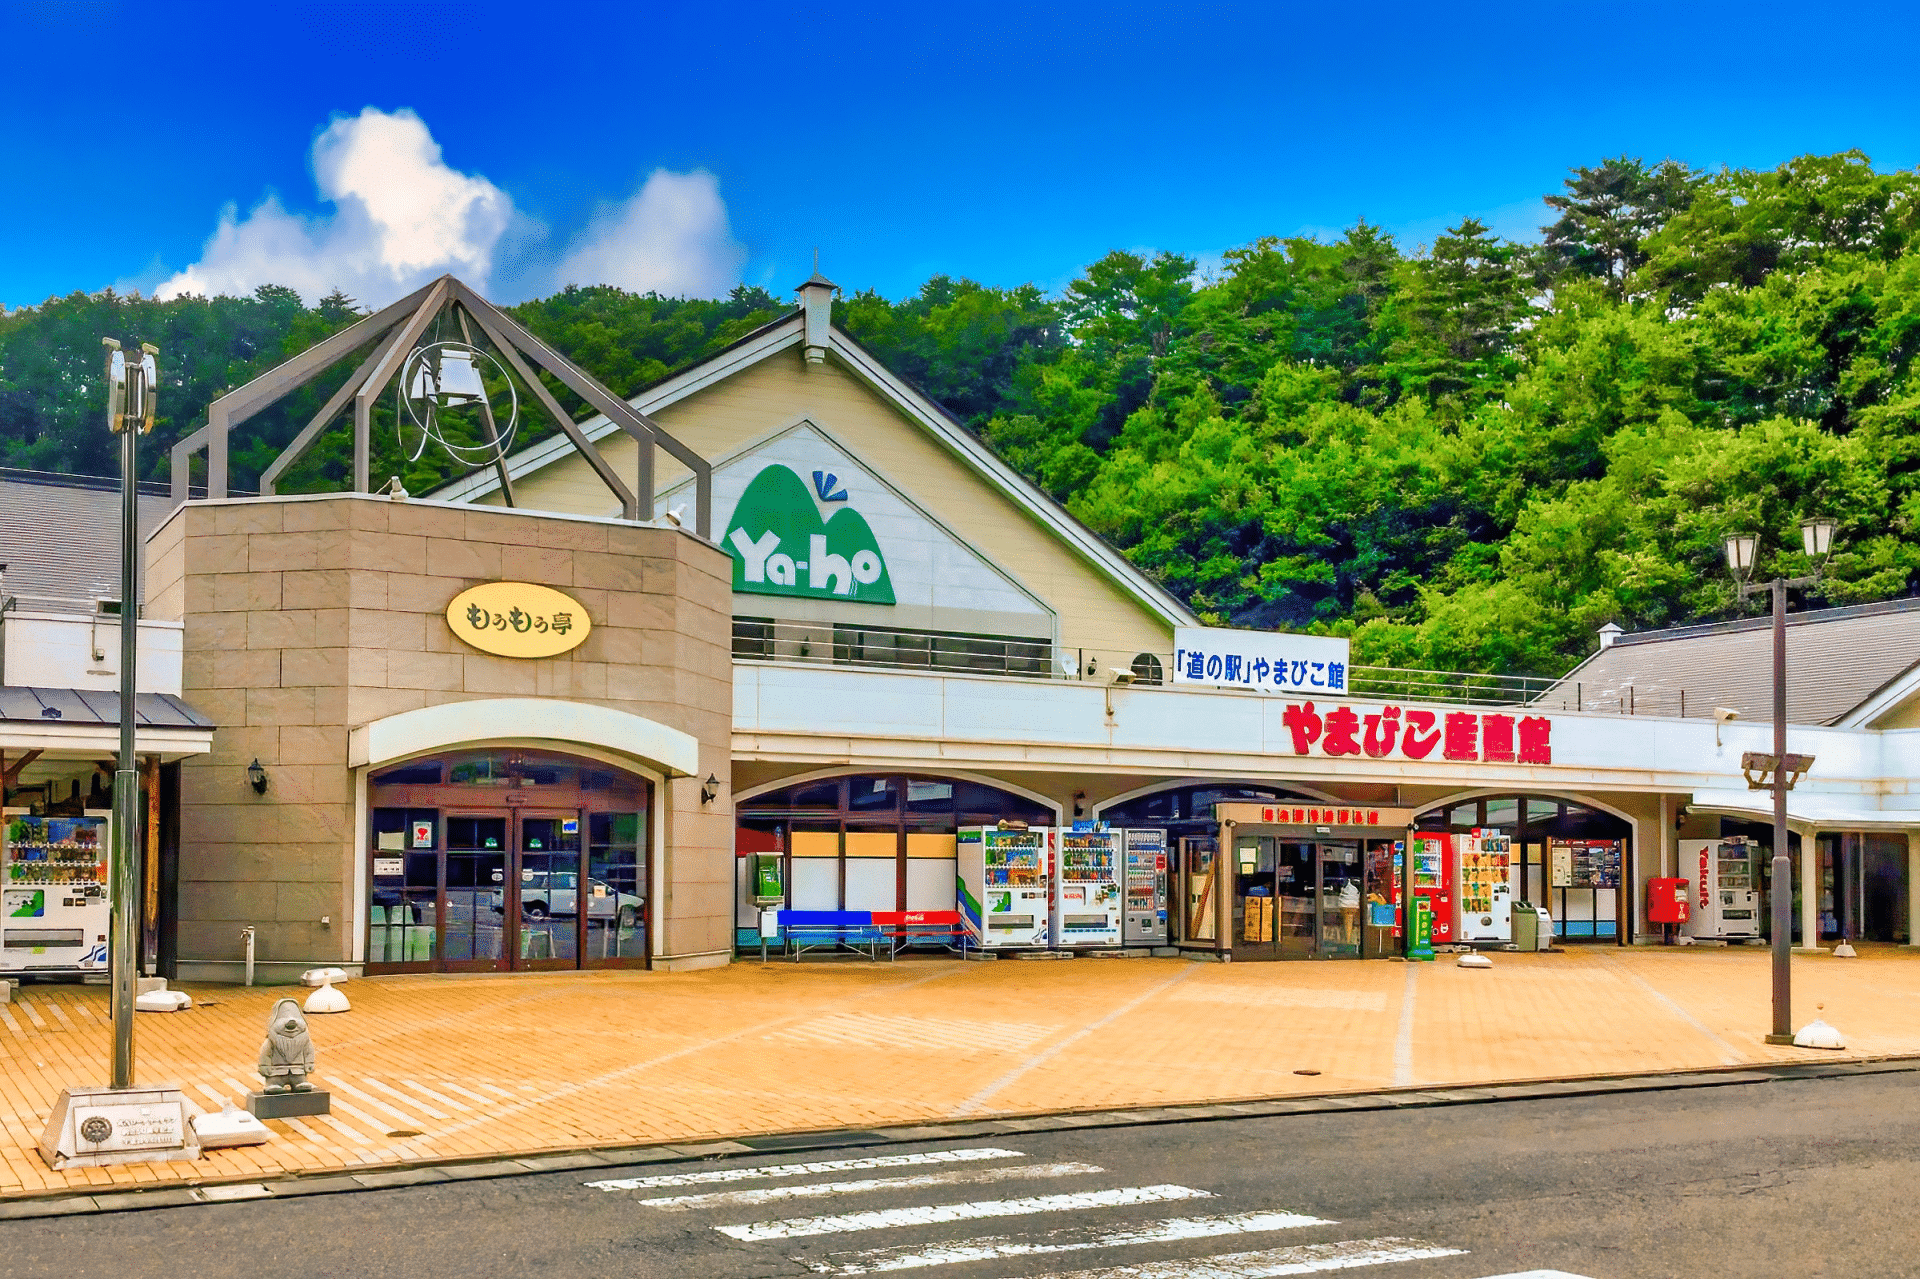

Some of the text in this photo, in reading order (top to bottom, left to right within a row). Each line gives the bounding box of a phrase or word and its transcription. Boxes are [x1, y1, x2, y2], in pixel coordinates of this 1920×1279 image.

[729, 527, 882, 595] Ya-ho
[1178, 649, 1345, 690] 「道の駅」やまびこ館
[1699, 845, 1709, 910] Yakult
